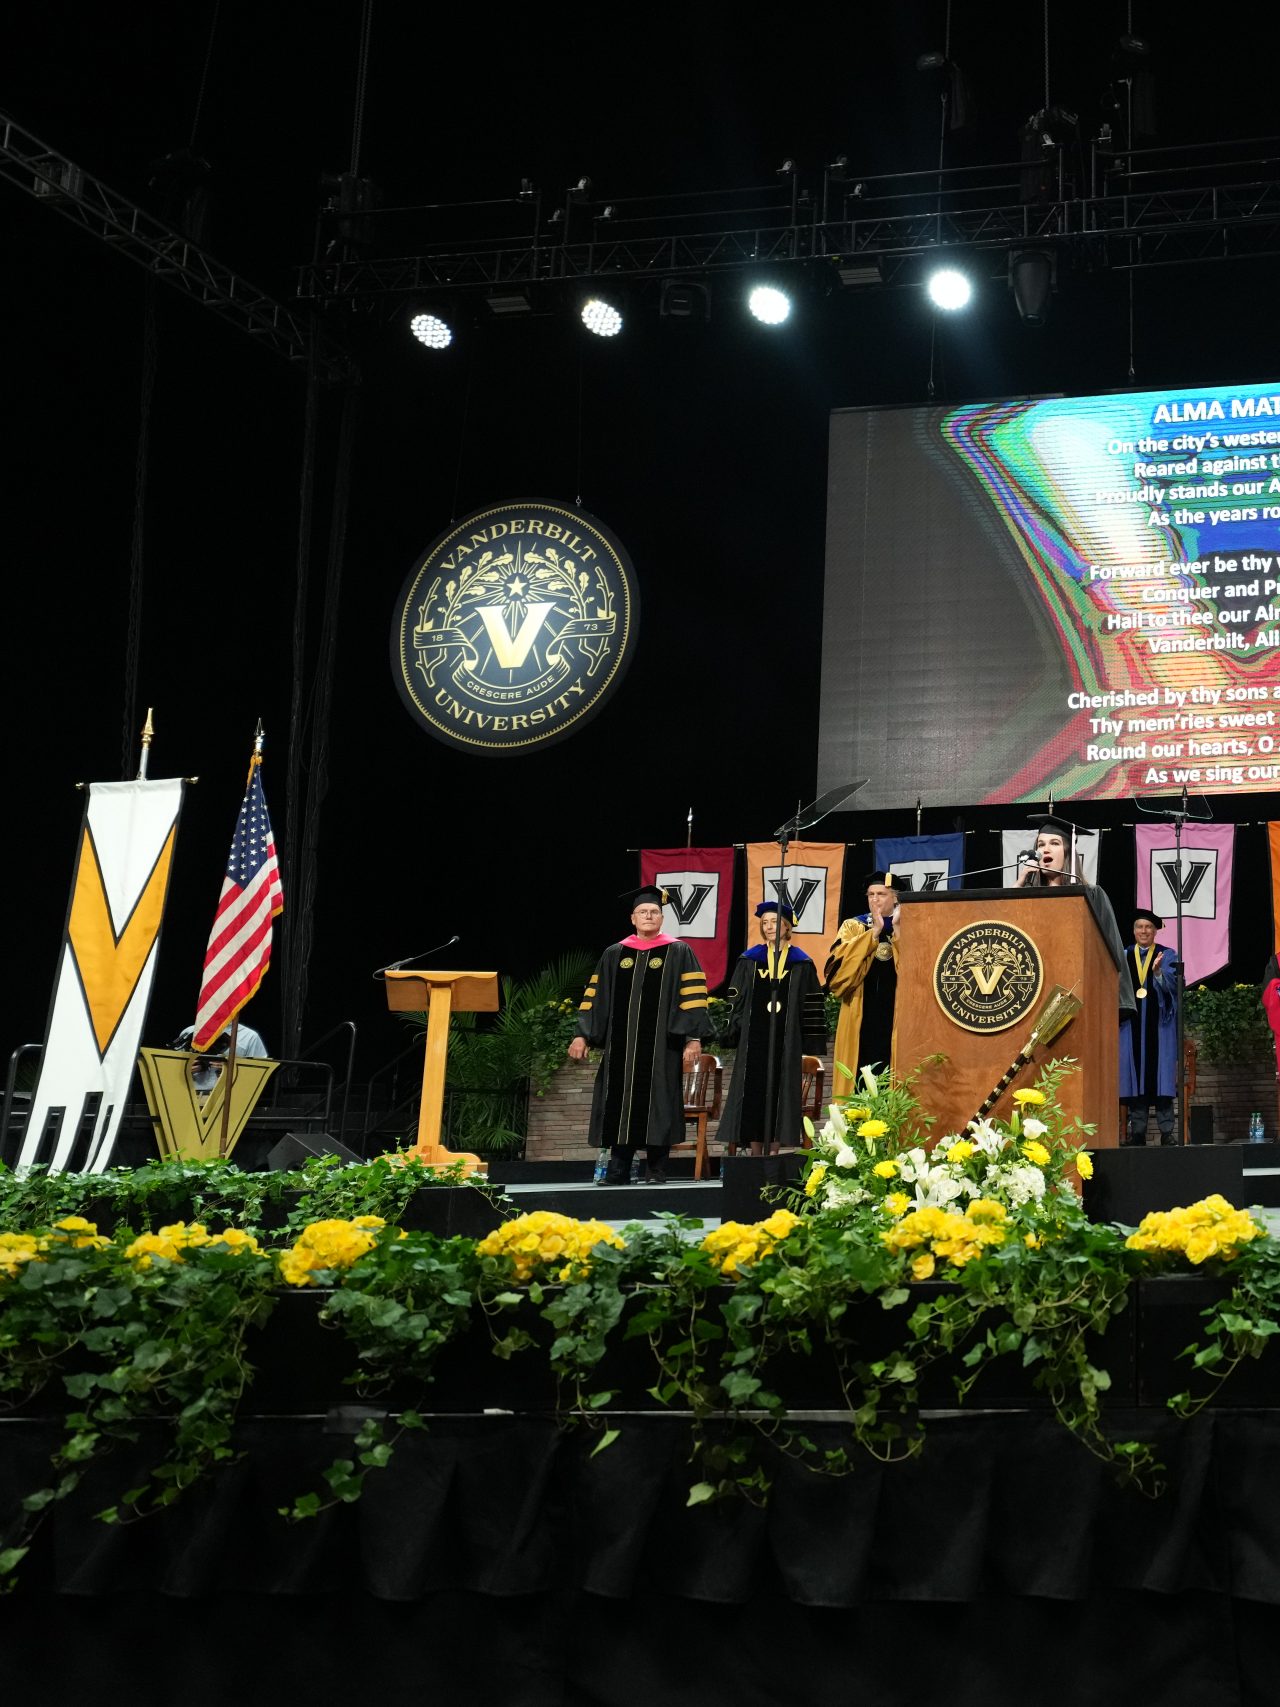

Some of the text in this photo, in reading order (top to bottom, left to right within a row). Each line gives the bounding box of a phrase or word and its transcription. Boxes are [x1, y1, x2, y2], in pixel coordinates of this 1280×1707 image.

[1153, 400, 1225, 424] ALMA
[1107, 440, 1134, 455] On
[1138, 437, 1169, 453] the
[1172, 432, 1219, 452] city's
[1134, 458, 1198, 478] Reared
[1202, 454, 1268, 476] against
[1095, 485, 1166, 504] Proudly
[1169, 481, 1228, 500] stands
[1232, 482, 1265, 496] our
[1147, 511, 1170, 527] As
[1174, 508, 1206, 525] the
[1209, 507, 1258, 526] years
[439, 518, 598, 571] VANDERBILT
[1089, 560, 1165, 580] Forward
[1169, 560, 1211, 575] ever
[1214, 556, 1238, 573] be
[1241, 554, 1273, 573] thy
[1142, 585, 1221, 603] Conquer
[1224, 579, 1259, 598] and
[1107, 610, 1143, 630] Hail
[1148, 612, 1168, 628] to
[1172, 609, 1214, 626] thee
[1218, 609, 1251, 624] our
[431, 622, 599, 642] 18 73
[473, 601, 558, 669] V
[1147, 631, 1251, 653] Vanderbilt,
[1254, 630, 1280, 647] All
[466, 674, 556, 700] CRESCERE AUDE
[1067, 688, 1159, 709] Cherished
[1164, 687, 1187, 707] by
[1190, 685, 1222, 705] thy
[1225, 686, 1268, 702] sons
[433, 676, 587, 731] UNIVERSITY
[1089, 716, 1124, 736] Thy
[1128, 713, 1215, 732] mem'ries
[1218, 710, 1276, 728] sweet
[1086, 741, 1146, 761] Round
[1151, 743, 1184, 758] our
[1188, 739, 1253, 757] hearts,
[1258, 736, 1274, 753] O
[1145, 767, 1169, 784] As
[1172, 768, 1201, 782] we
[1205, 765, 1244, 784] sing
[1248, 764, 1280, 779] our
[1156, 861, 1212, 903] V
[660, 884, 715, 925] V
[768, 878, 821, 918] V
[953, 928, 1027, 951] VANDERBILT
[968, 965, 1008, 995] V
[951, 1000, 1023, 1024] UNIVERSITY
